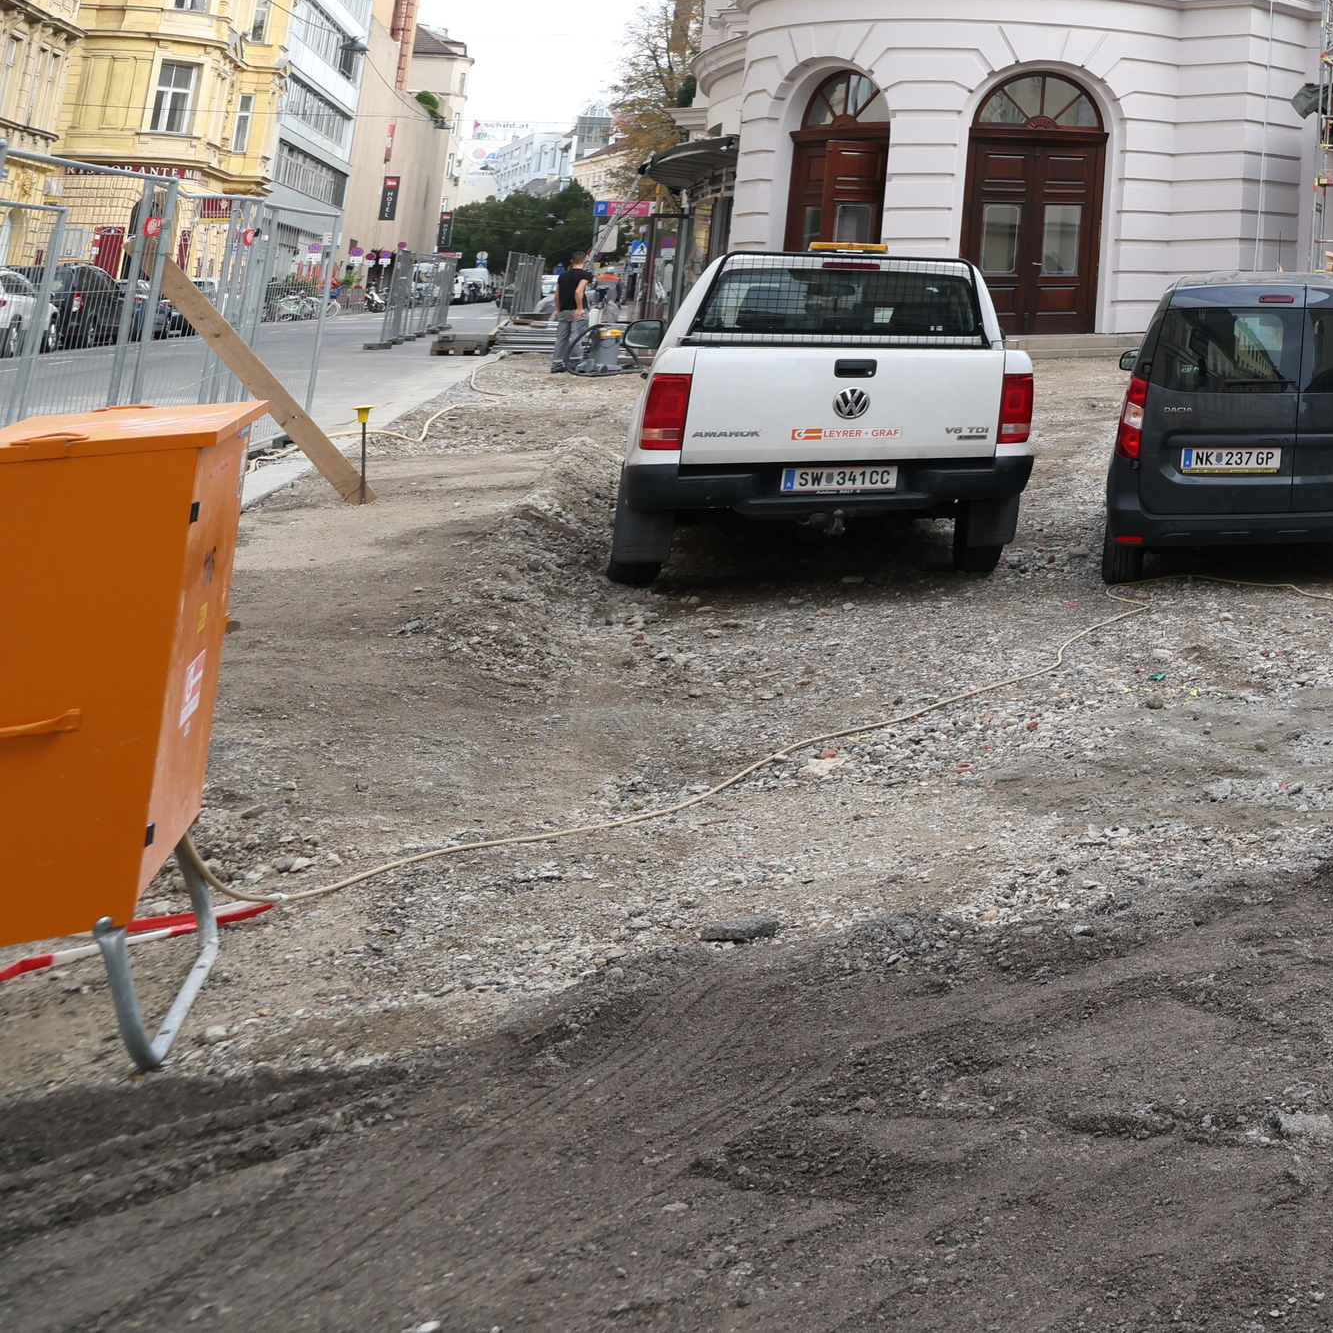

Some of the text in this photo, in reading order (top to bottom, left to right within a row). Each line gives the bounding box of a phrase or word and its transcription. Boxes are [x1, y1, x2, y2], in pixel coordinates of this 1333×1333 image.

[384, 191, 393, 217] HOTEL
[692, 429, 762, 438] AMAROK
[823, 429, 862, 438] LEYRER
[871, 429, 900, 437] GRAF
[945, 426, 963, 434] V6
[1195, 451, 1214, 466] NK
[1225, 451, 1253, 465] 237
[1256, 451, 1274, 465] GP
[798, 471, 824, 486] SW
